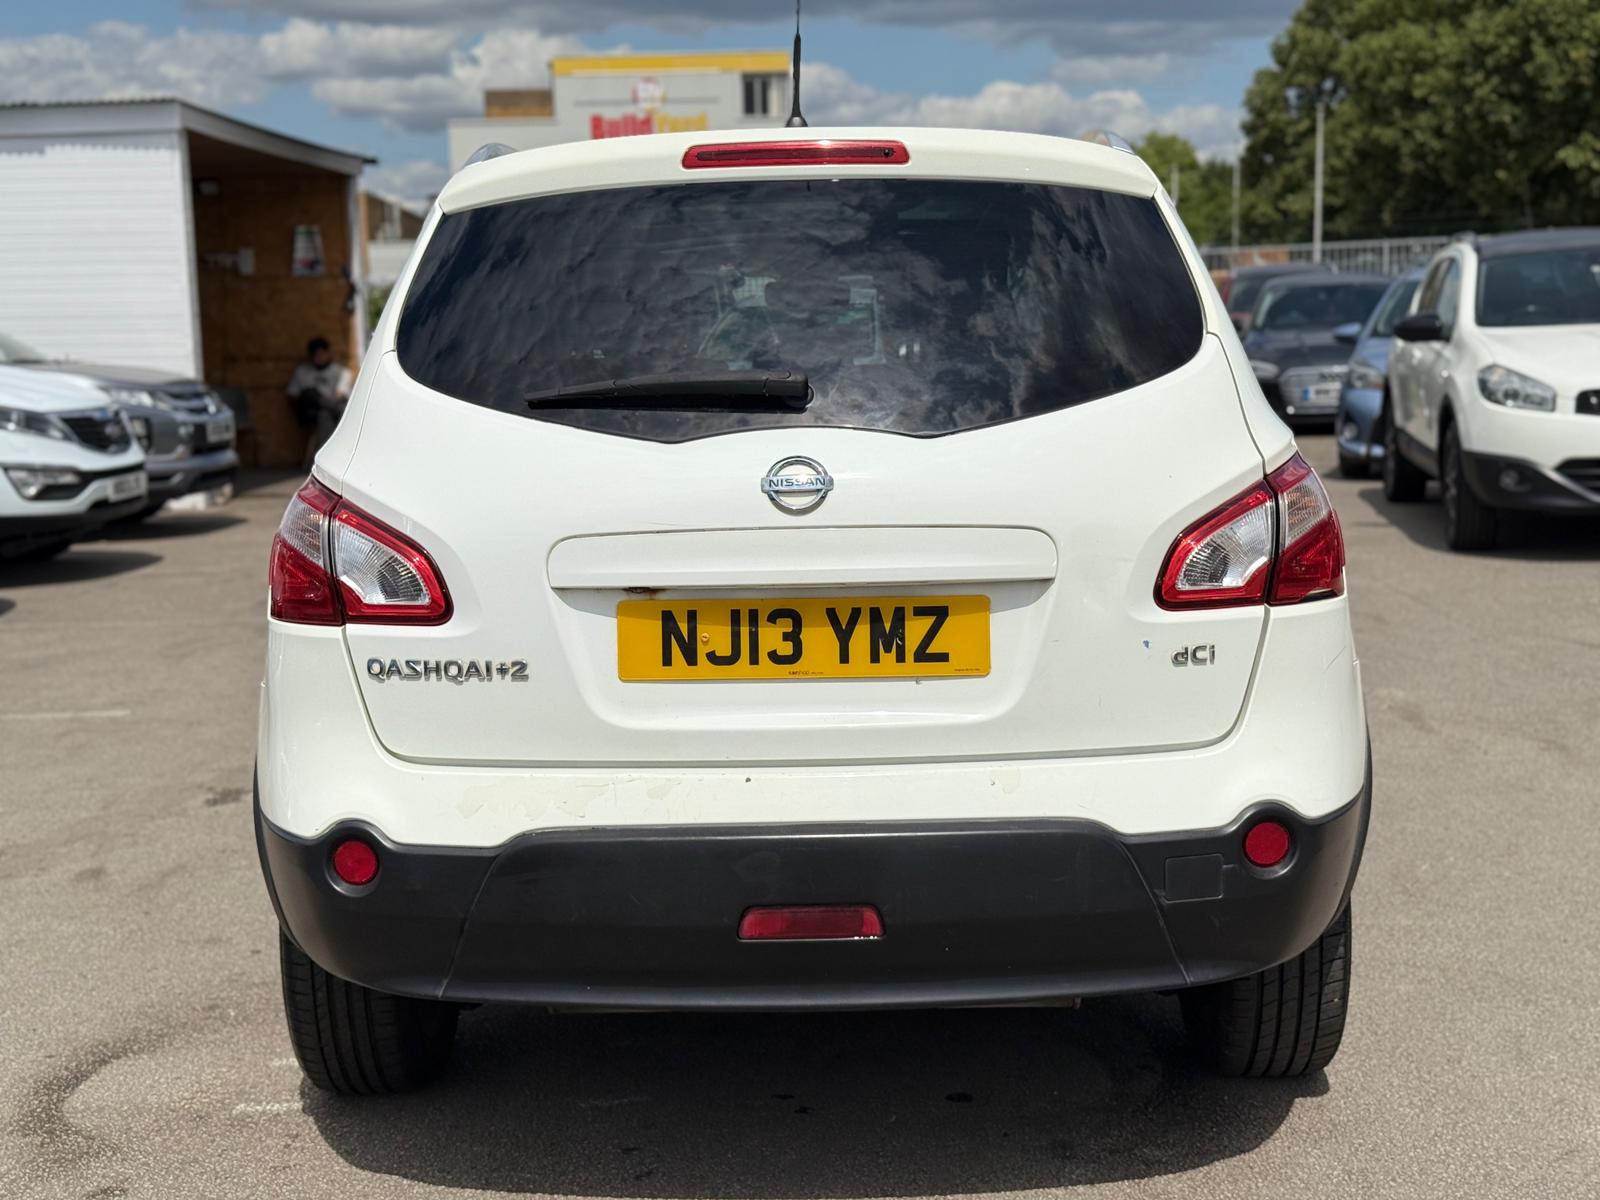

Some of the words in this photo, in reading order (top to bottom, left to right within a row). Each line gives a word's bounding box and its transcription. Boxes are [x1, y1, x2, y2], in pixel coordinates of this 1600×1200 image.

[768, 477, 826, 488] NISSAN
[660, 608, 803, 667] NJ13
[825, 605, 950, 665] YMZ
[1171, 644, 1216, 667] dCi
